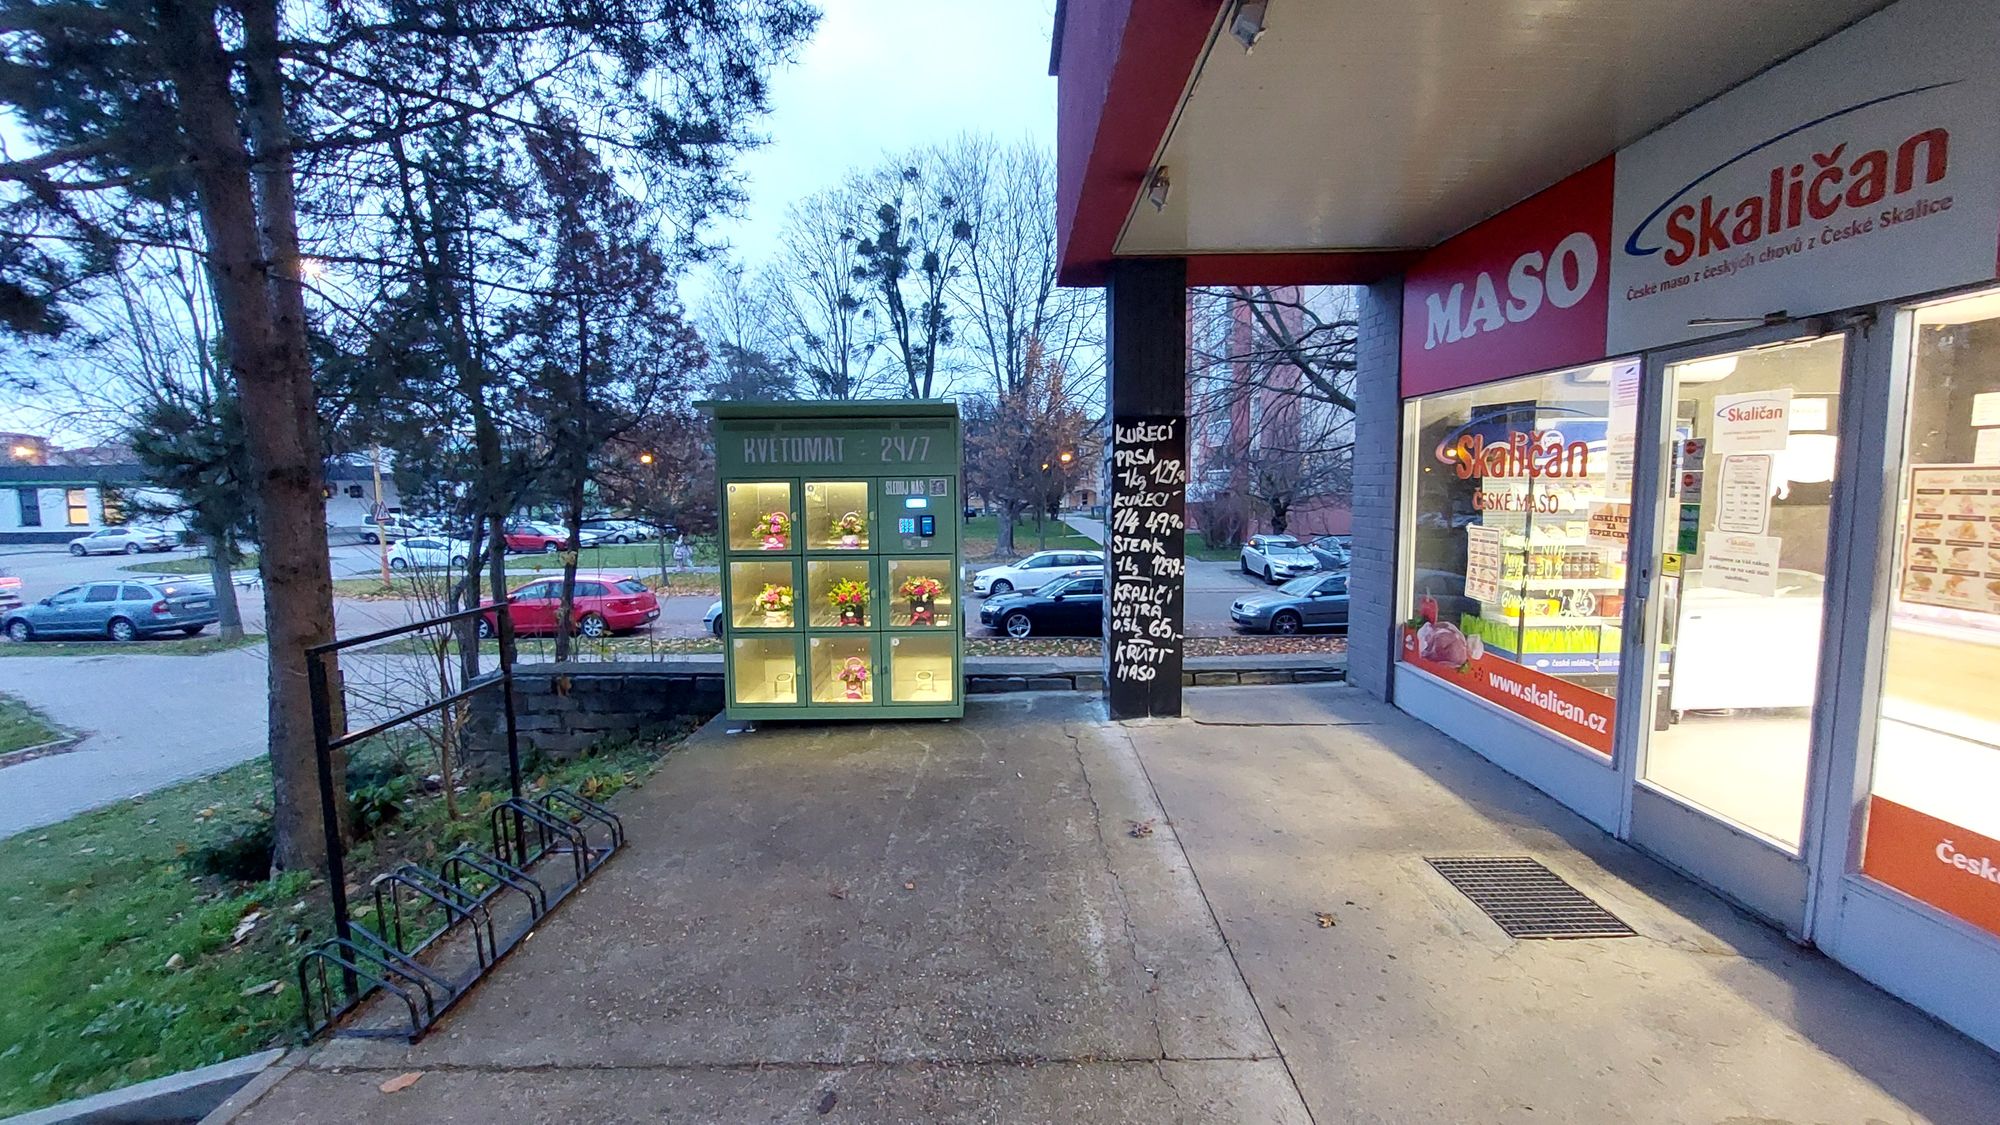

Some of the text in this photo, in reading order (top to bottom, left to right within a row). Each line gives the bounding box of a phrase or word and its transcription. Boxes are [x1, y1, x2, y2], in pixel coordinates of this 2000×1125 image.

[1664, 128, 1948, 266] Skaličan
[1660, 274, 1690, 292] maso
[1694, 271, 1700, 282] z
[1704, 252, 1755, 276] českých
[1759, 236, 1802, 263] chovů
[1807, 237, 1815, 250] z
[1820, 216, 1873, 246] České
[1880, 196, 1953, 228] Skalice
[1424, 232, 1598, 350] MASO
[1728, 405, 1783, 421] Skaličan
[1115, 419, 1176, 444] KUŘECÍ
[881, 436, 931, 462] 24/7
[1114, 449, 1154, 467] PRSA
[1456, 431, 1588, 480] Skaličan
[1118, 467, 1146, 490] 1kg
[1113, 491, 1181, 508] KUŘECÍ
[1472, 487, 1559, 514] ČESKÉ MASO
[1114, 508, 1139, 534] 1/4
[1113, 535, 1166, 554] STEAK
[1113, 582, 1180, 604] KRALIČÍ
[1489, 672, 1607, 734] www.skalican.cz
[1935, 838, 2000, 885] Česk
